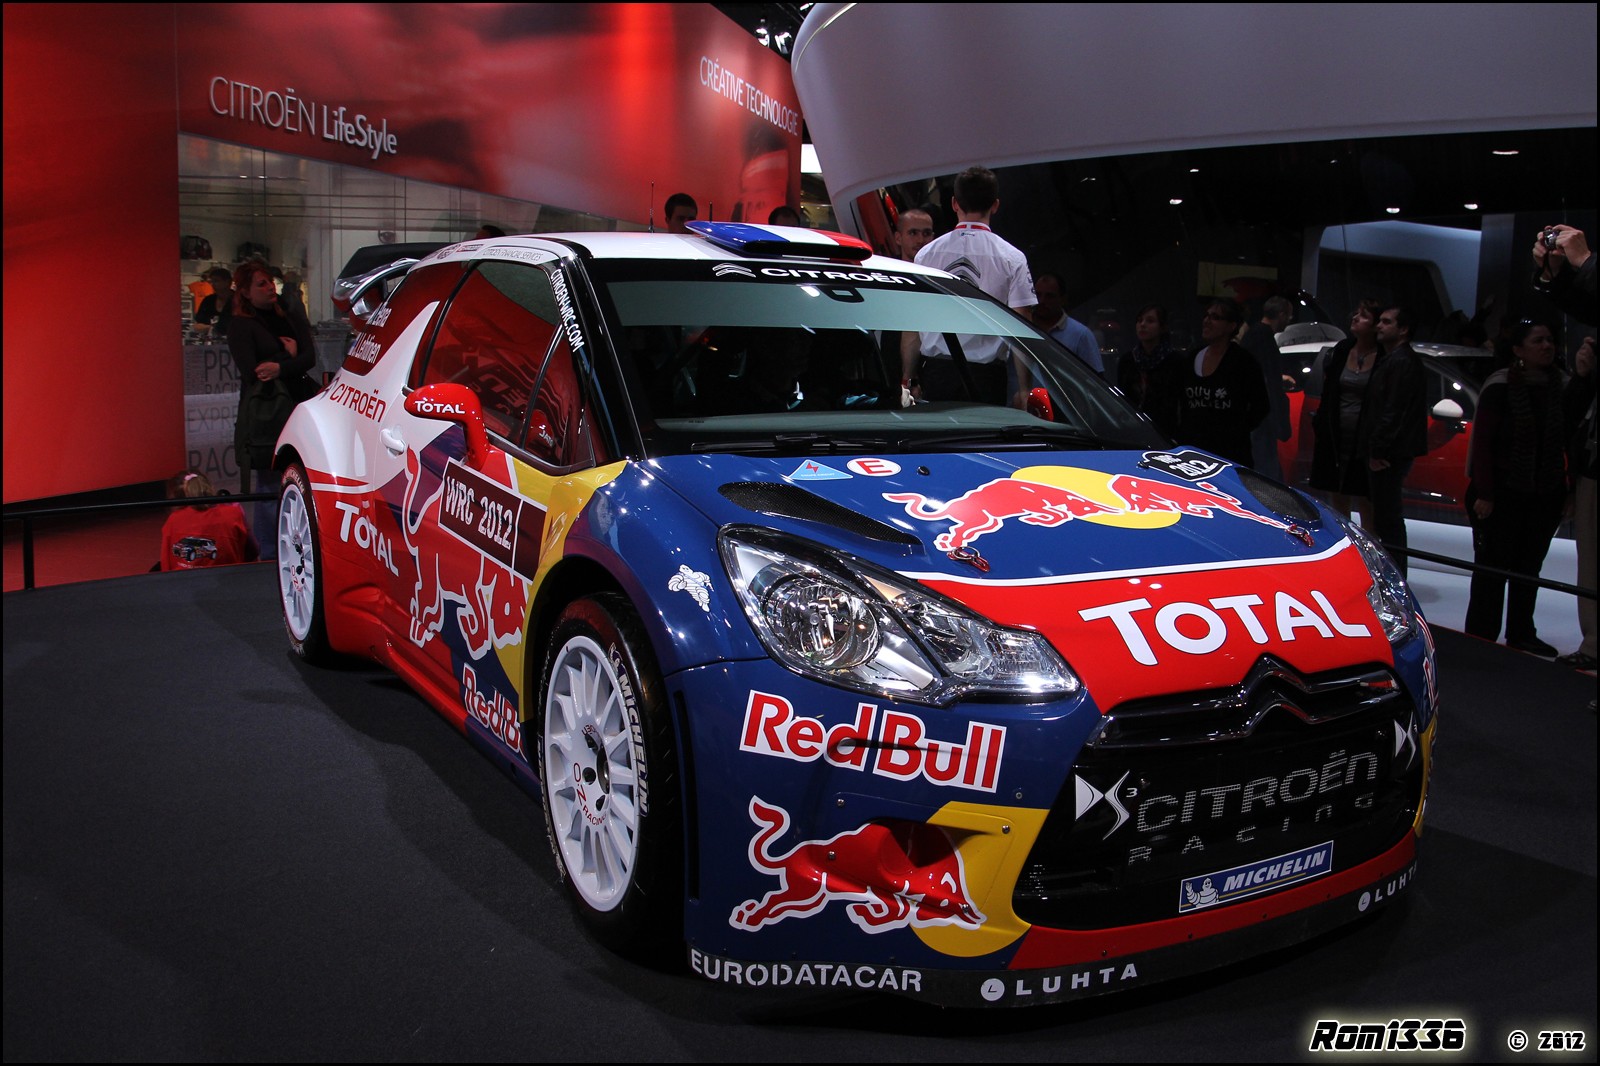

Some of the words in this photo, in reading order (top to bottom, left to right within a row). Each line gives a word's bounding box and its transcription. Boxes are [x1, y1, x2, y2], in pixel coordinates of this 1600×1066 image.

[209, 76, 316, 136] CITROËN
[322, 104, 398, 160] LifeStyle
[700, 56, 744, 106] CRÉATIVE
[745, 82, 799, 136] TECHNOLOGIE
[550, 268, 586, 353] CITROEN-WRC.COM
[760, 266, 917, 286] CITROËN
[203, 349, 242, 382] PR
[330, 382, 386, 423] CITROËN
[414, 397, 466, 414] TOTAL
[856, 460, 893, 475] E
[335, 500, 400, 577] TOTAL
[445, 475, 475, 526] WRC
[478, 495, 514, 551] 2012
[1078, 589, 1373, 667] TOTAL
[463, 662, 505, 742] Red
[501, 696, 528, 762] B
[618, 675, 650, 818] MICHELIN
[739, 689, 878, 772] Red
[872, 709, 1008, 794] Bull
[1127, 791, 1375, 867] RACING
[1136, 749, 1379, 834] CITROËN
[1222, 848, 1328, 893] MICHELIN
[690, 948, 924, 993] EURODATACAR
[1015, 962, 1139, 997] LUHTA
